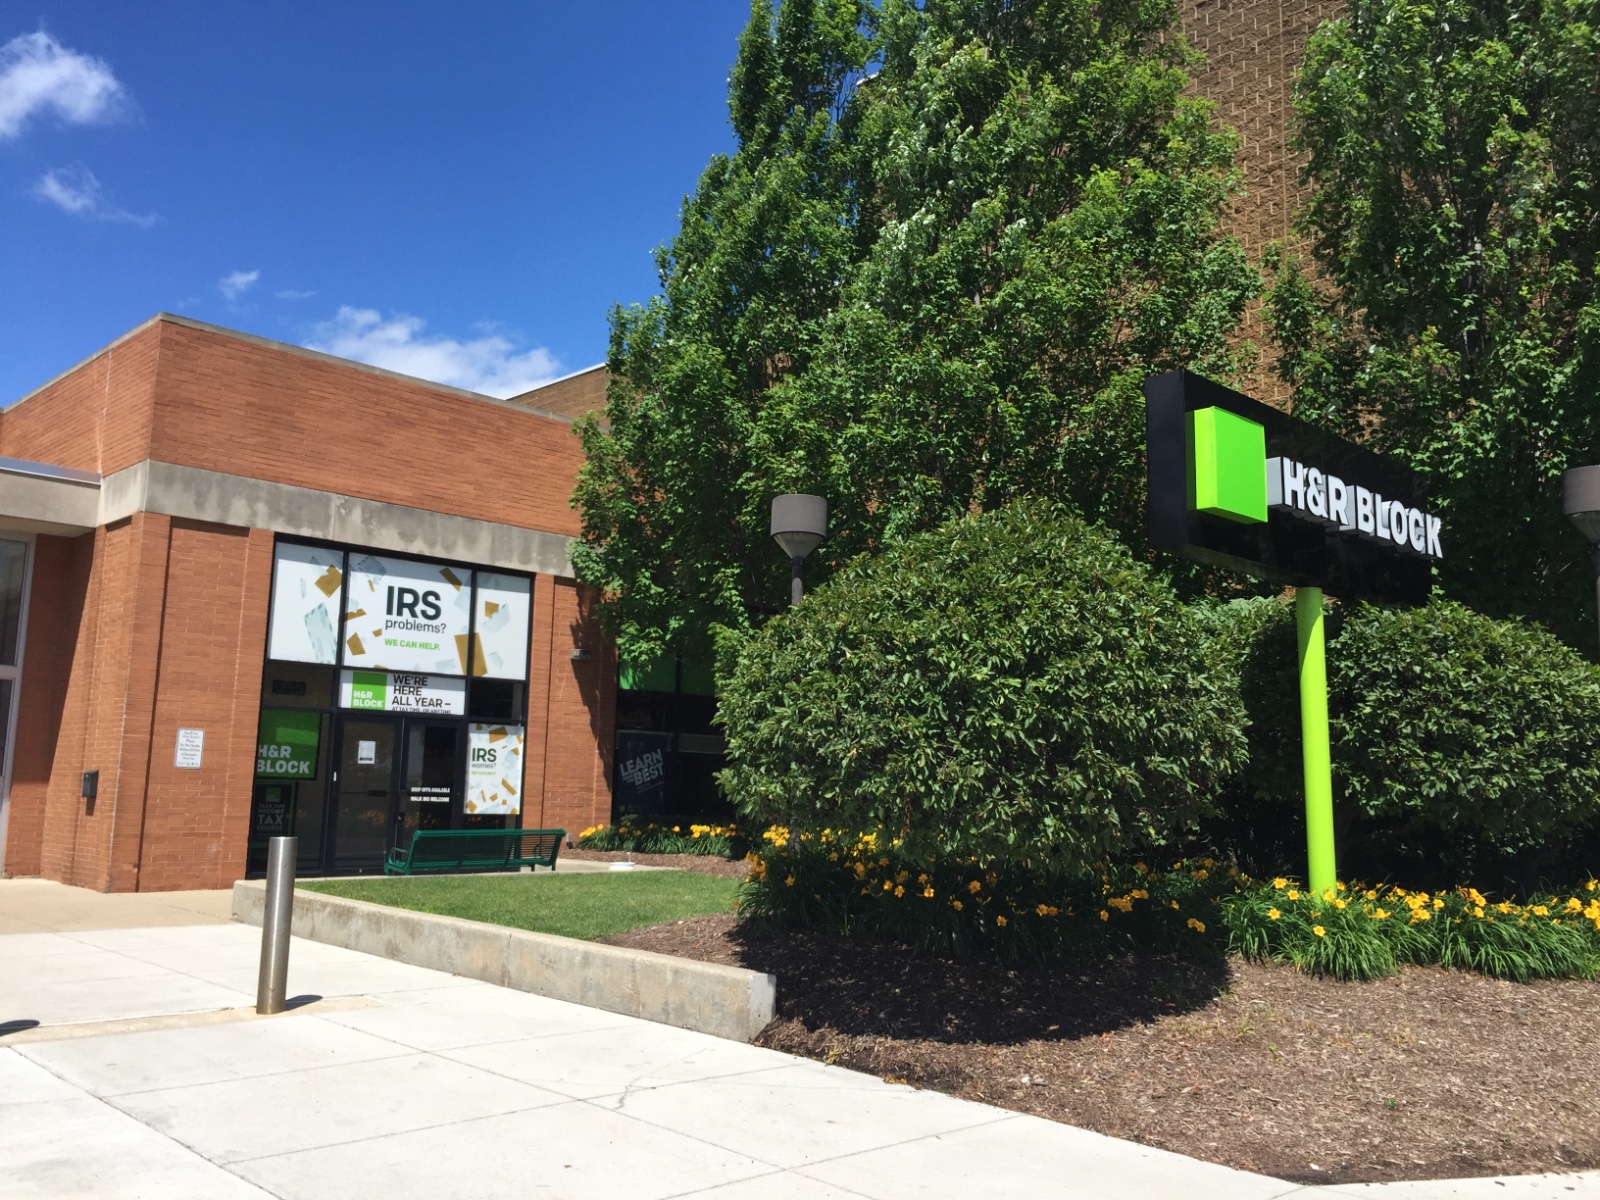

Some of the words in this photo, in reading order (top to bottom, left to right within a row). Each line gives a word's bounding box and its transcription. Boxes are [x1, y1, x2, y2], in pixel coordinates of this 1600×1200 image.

[1282, 456, 1349, 526] H&R
[1355, 485, 1443, 558] BLOCK
[386, 585, 442, 621] IRS
[385, 619, 447, 634] problems?
[384, 638, 398, 647] WE
[399, 640, 417, 648] CAN
[393, 674, 428, 686] WE'RE
[353, 690, 373, 699] H&R
[393, 685, 423, 696] HERE
[353, 699, 383, 708] BLOCK
[391, 696, 414, 706] ALL
[414, 697, 443, 708] YEAR
[258, 744, 291, 759] H&R
[472, 747, 497, 762] IRS
[257, 759, 310, 774] BLOCK
[619, 748, 663, 777] LEARN
[633, 761, 664, 786] BEST
[257, 814, 284, 825] TAX
